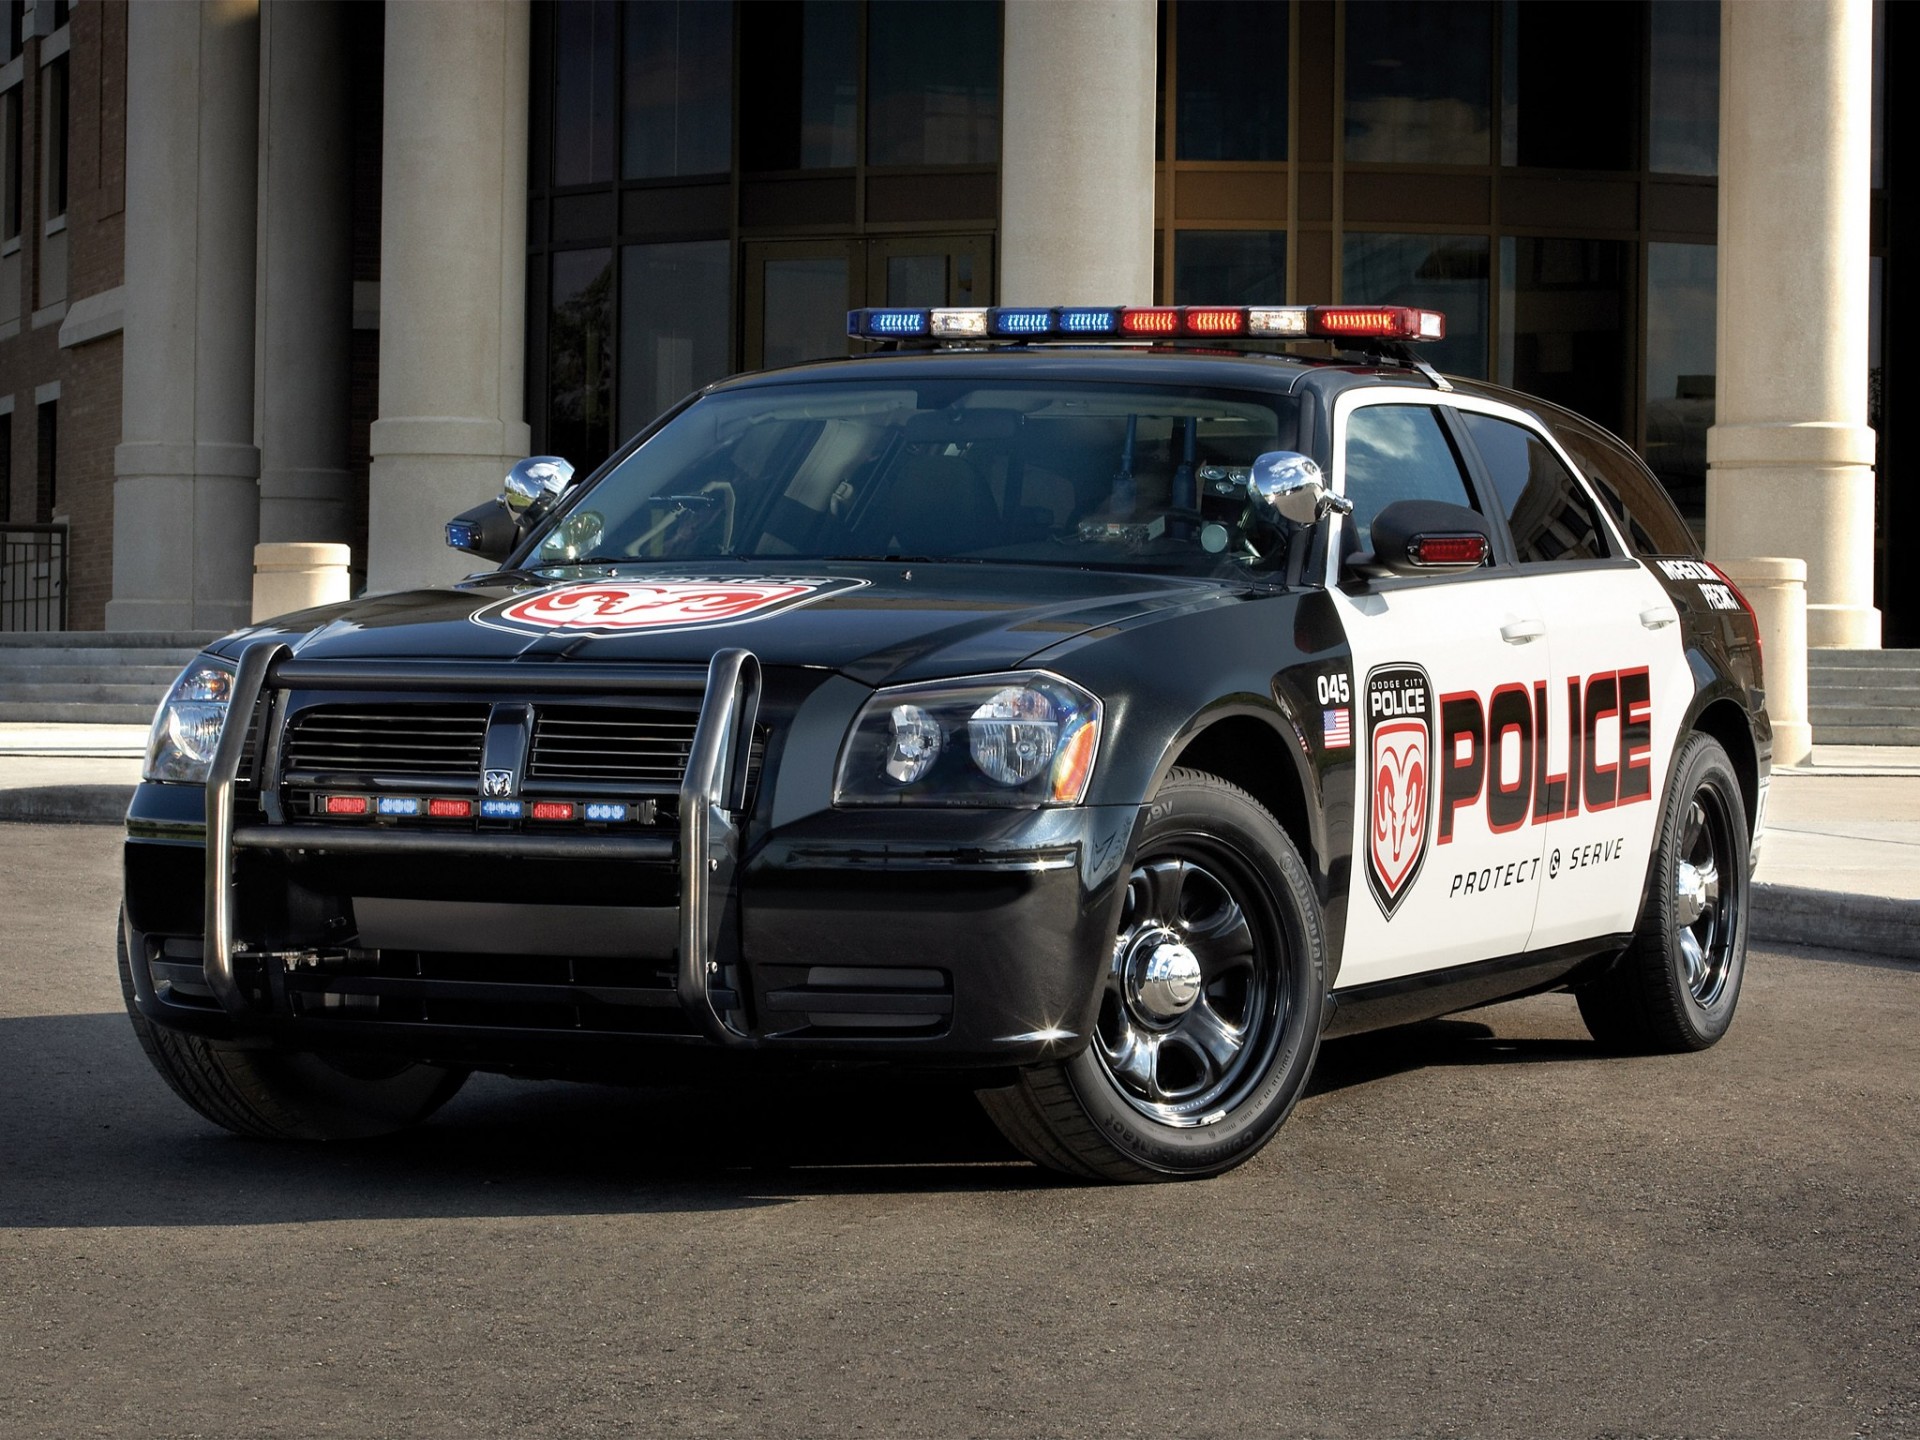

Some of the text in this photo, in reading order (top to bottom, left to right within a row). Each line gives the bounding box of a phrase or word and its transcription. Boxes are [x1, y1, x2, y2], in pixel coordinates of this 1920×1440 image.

[1317, 673, 1350, 705] 045
[1371, 678, 1425, 690] DODGE CITY
[1370, 688, 1426, 717] POLICE
[1437, 665, 1652, 846] POLICE
[1144, 800, 1173, 826] 9V
[1449, 856, 1541, 898] PROTECT
[1569, 837, 1625, 871] SERVE
